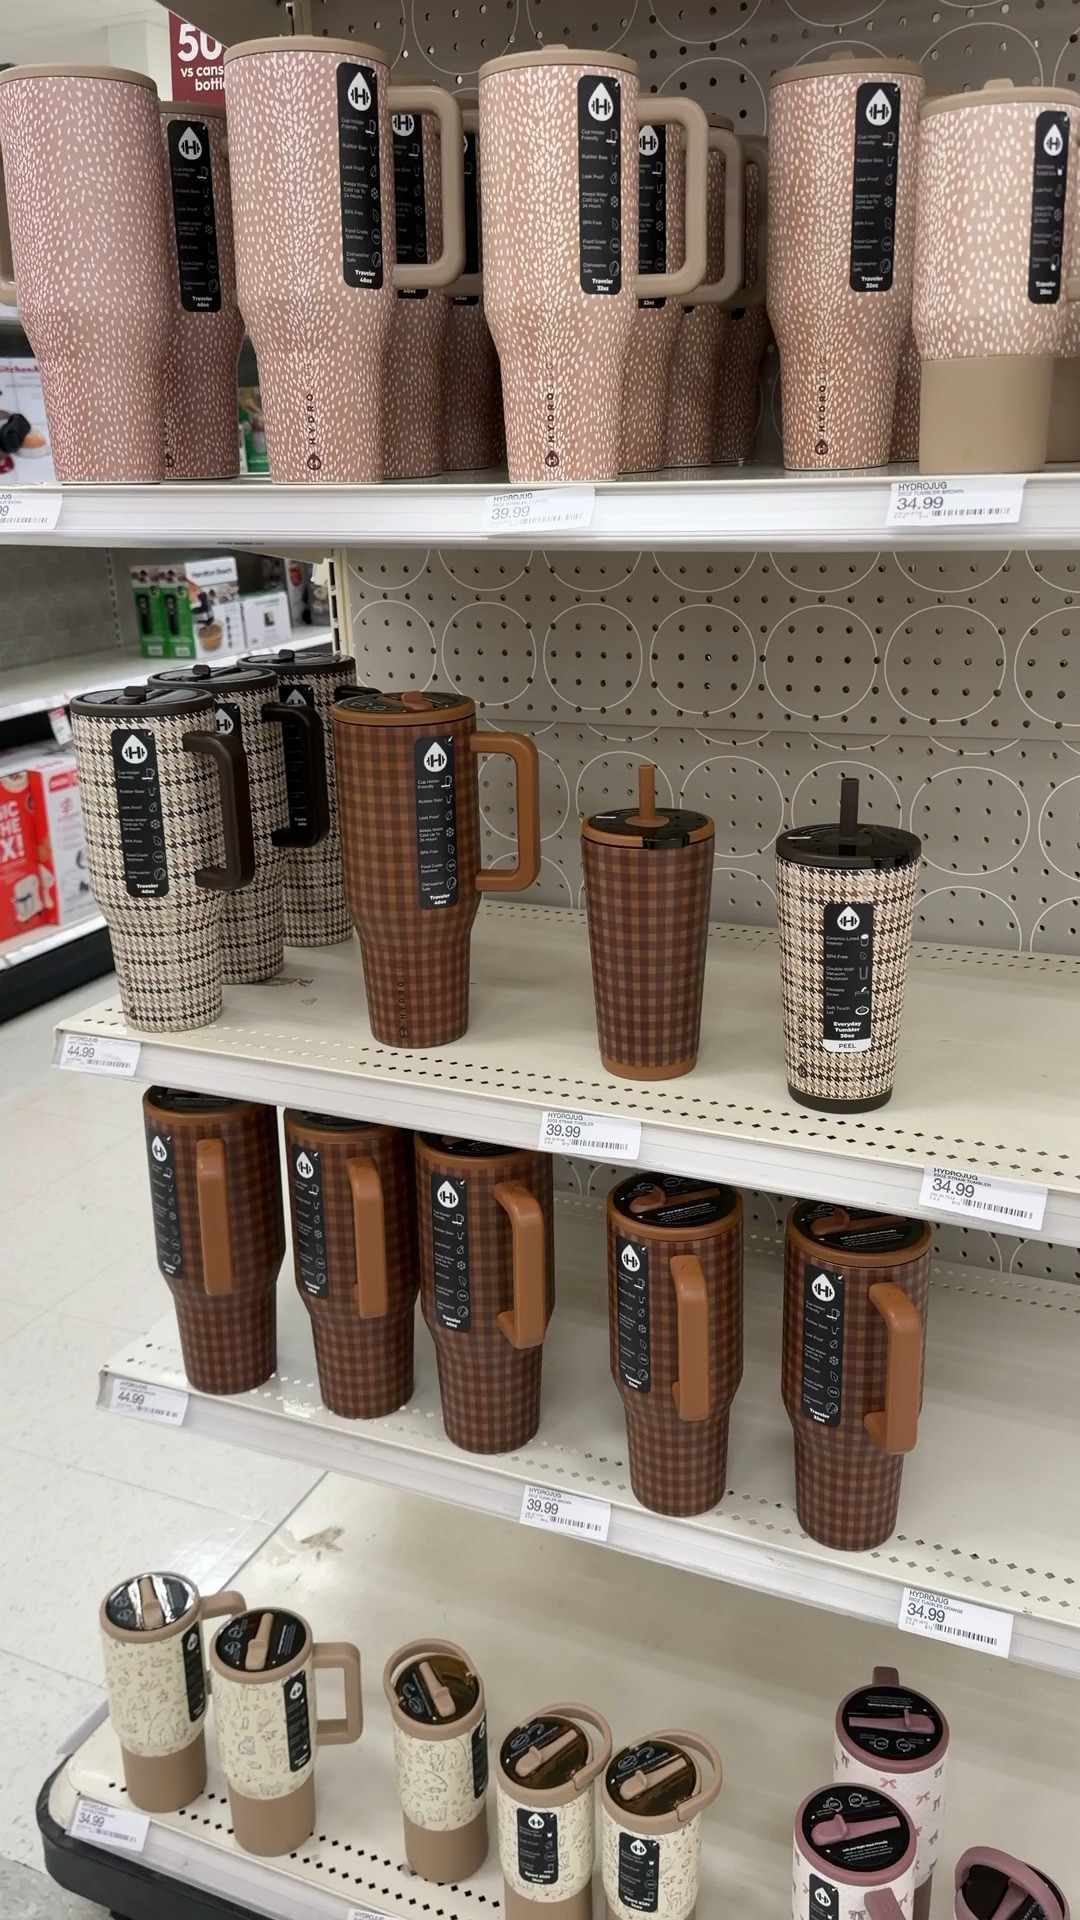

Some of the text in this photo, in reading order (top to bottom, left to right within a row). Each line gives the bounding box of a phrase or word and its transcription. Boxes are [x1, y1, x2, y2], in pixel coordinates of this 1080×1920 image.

[181, 65, 224, 78] vs cans
[195, 77, 225, 91] bottl
[354, 269, 376, 277] Traveler
[898, 482, 947, 491] HYDROJUG
[493, 492, 533, 503] HYDROJUG
[896, 496, 944, 511] 34.99
[491, 505, 530, 520] 39.99
[67, 1045, 95, 1058] 44.99
[547, 1112, 584, 1121] HYDROJUG
[546, 1123, 581, 1138] 39.99
[933, 1167, 979, 1181] HYDROJUG
[932, 1178, 975, 1198] 34.99
[118, 1391, 145, 1405] 44.99
[809, 1407, 830, 1419] Traveler
[528, 1487, 562, 1499] HYDROJUG
[526, 1498, 559, 1515] 39.99
[909, 1589, 949, 1605] HYDROJUG
[907, 1602, 945, 1623] 34.99
[79, 1811, 105, 1828] 34.99
